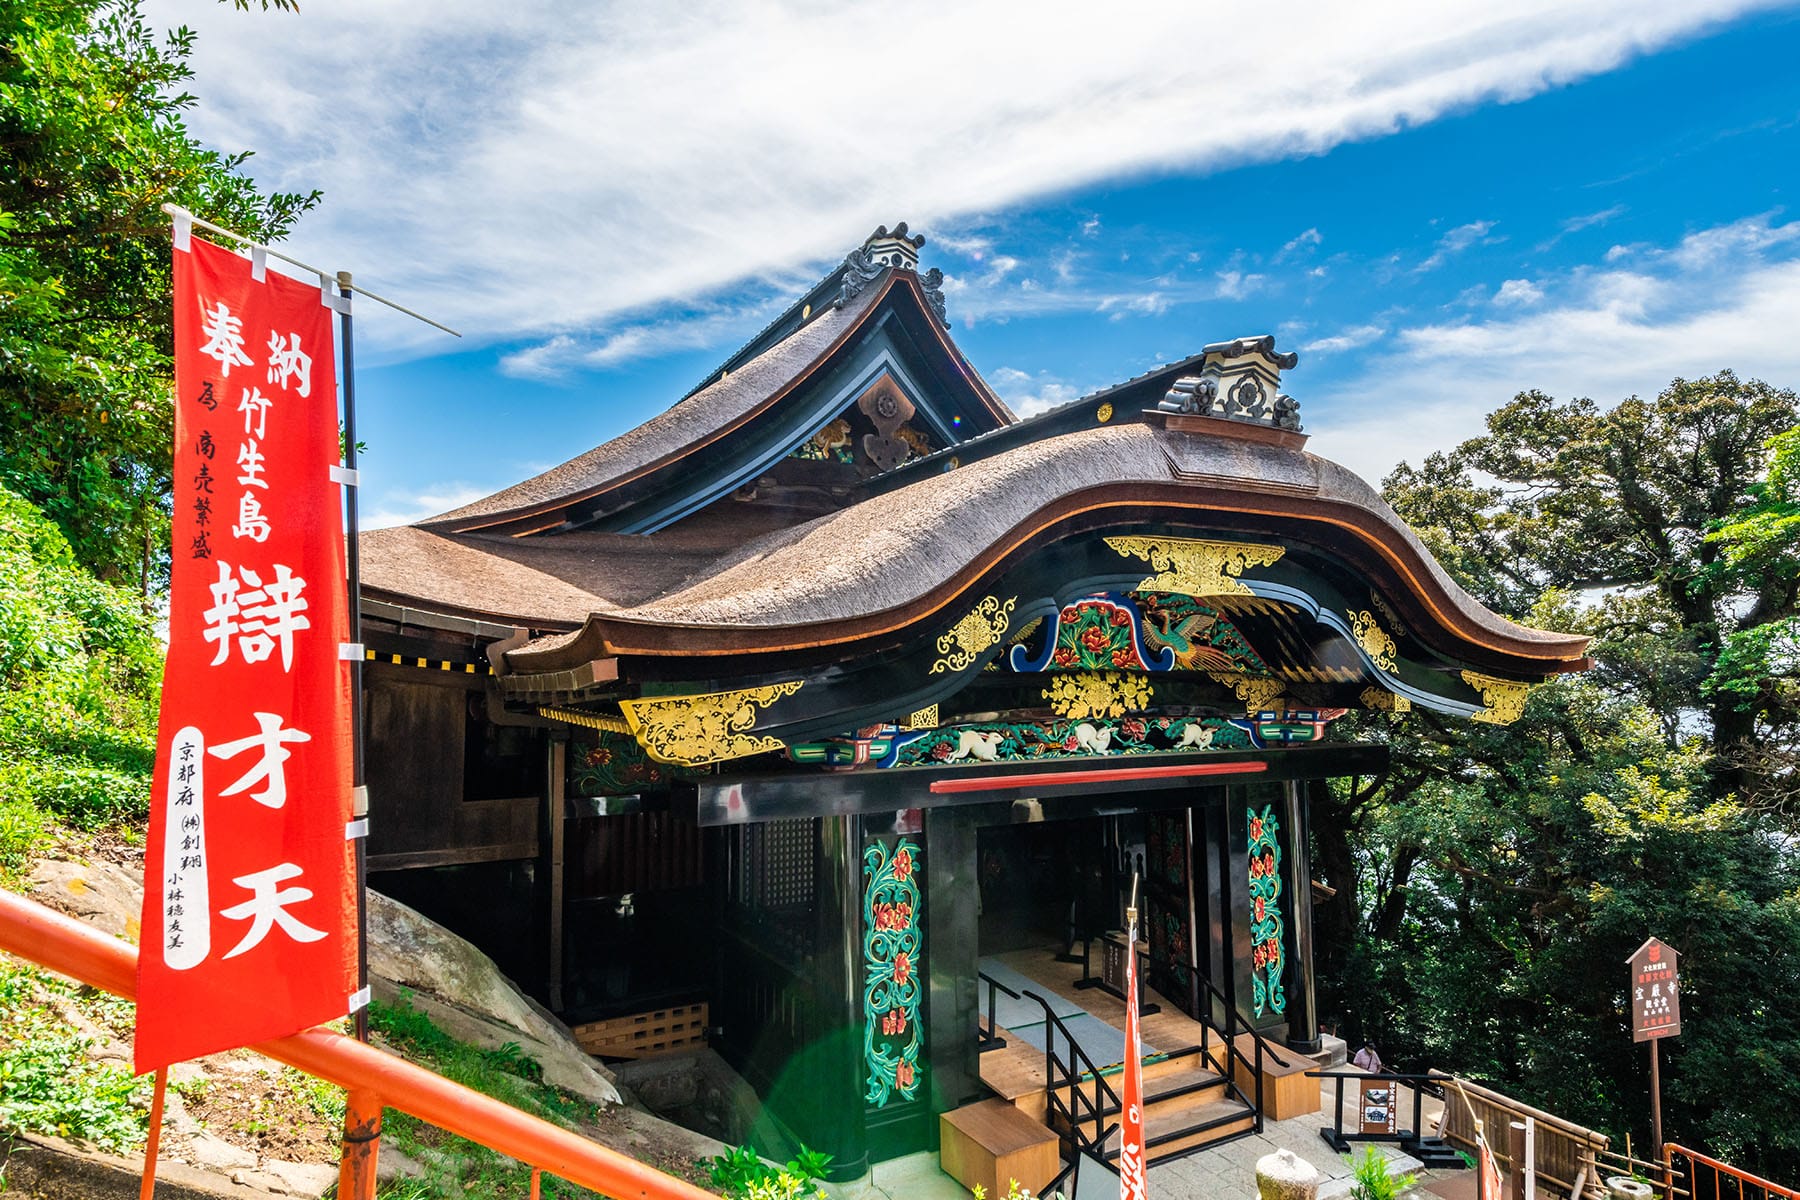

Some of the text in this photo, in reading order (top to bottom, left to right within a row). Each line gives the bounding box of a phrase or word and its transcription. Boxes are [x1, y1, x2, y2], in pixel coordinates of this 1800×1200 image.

[199, 301, 312, 398] 奉納
[191, 430, 215, 559] 商売繁盛
[232, 387, 272, 543] 竹生島
[175, 742, 196, 806] 京都府
